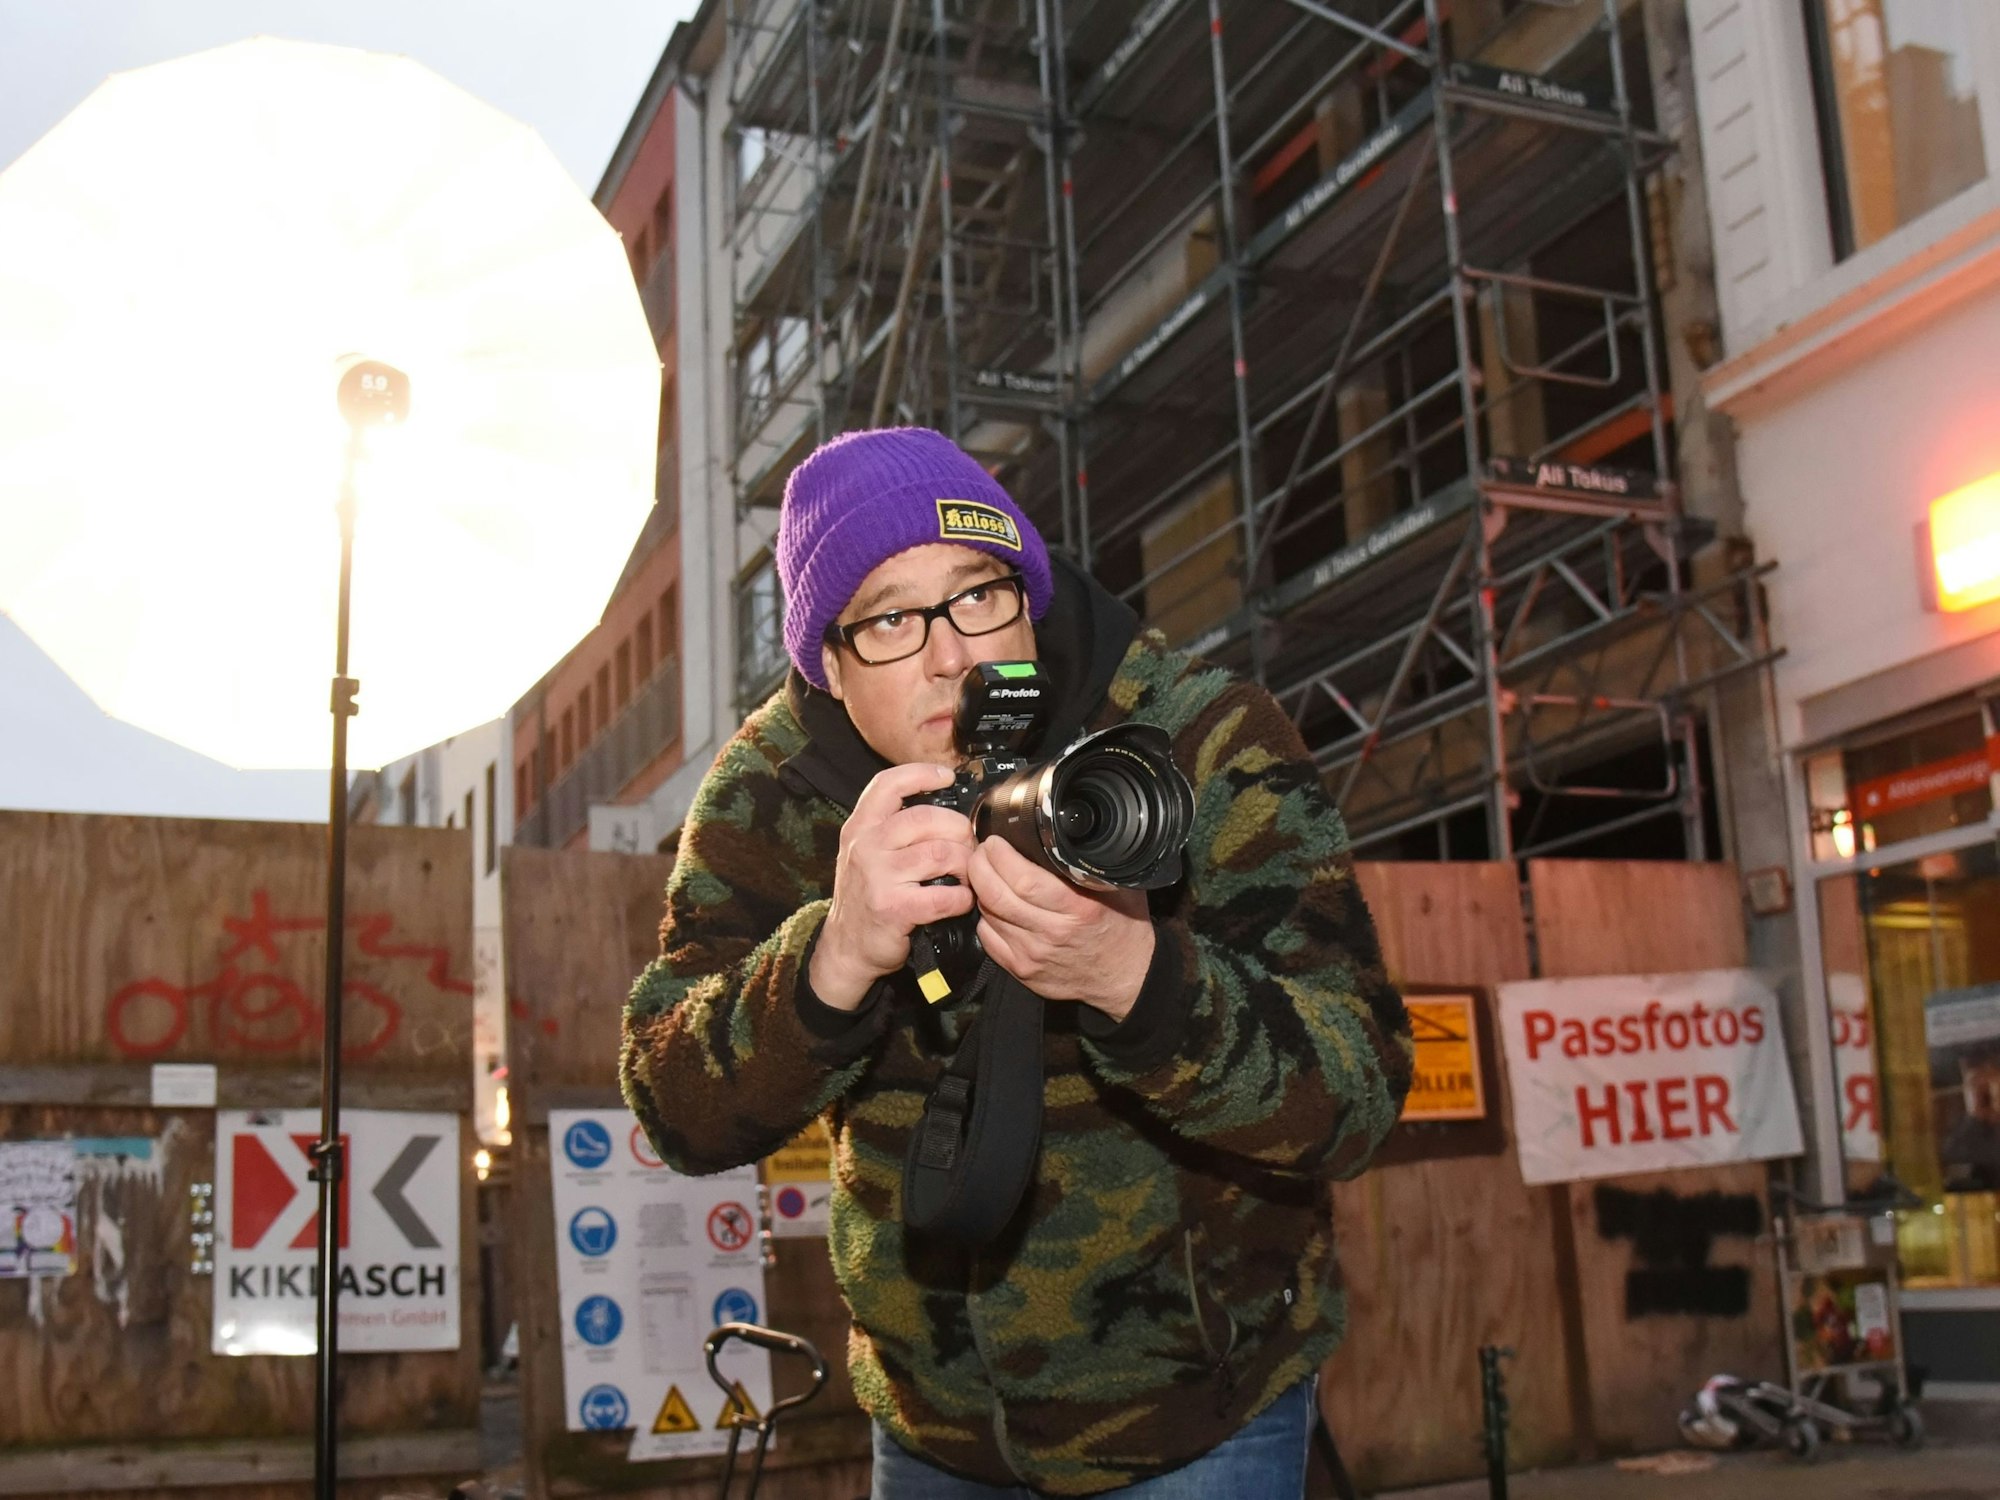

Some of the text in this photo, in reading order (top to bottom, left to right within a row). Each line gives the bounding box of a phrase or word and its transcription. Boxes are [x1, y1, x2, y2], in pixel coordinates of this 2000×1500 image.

[1499, 73, 1587, 107] Ali Tokus
[1536, 463, 1628, 494] Ali Tokus
[945, 508, 1006, 535] Koloss
[1001, 688, 1040, 699] Profoto
[1522, 1002, 1765, 1060] Passfotos
[1574, 1074, 1740, 1148] HIER
